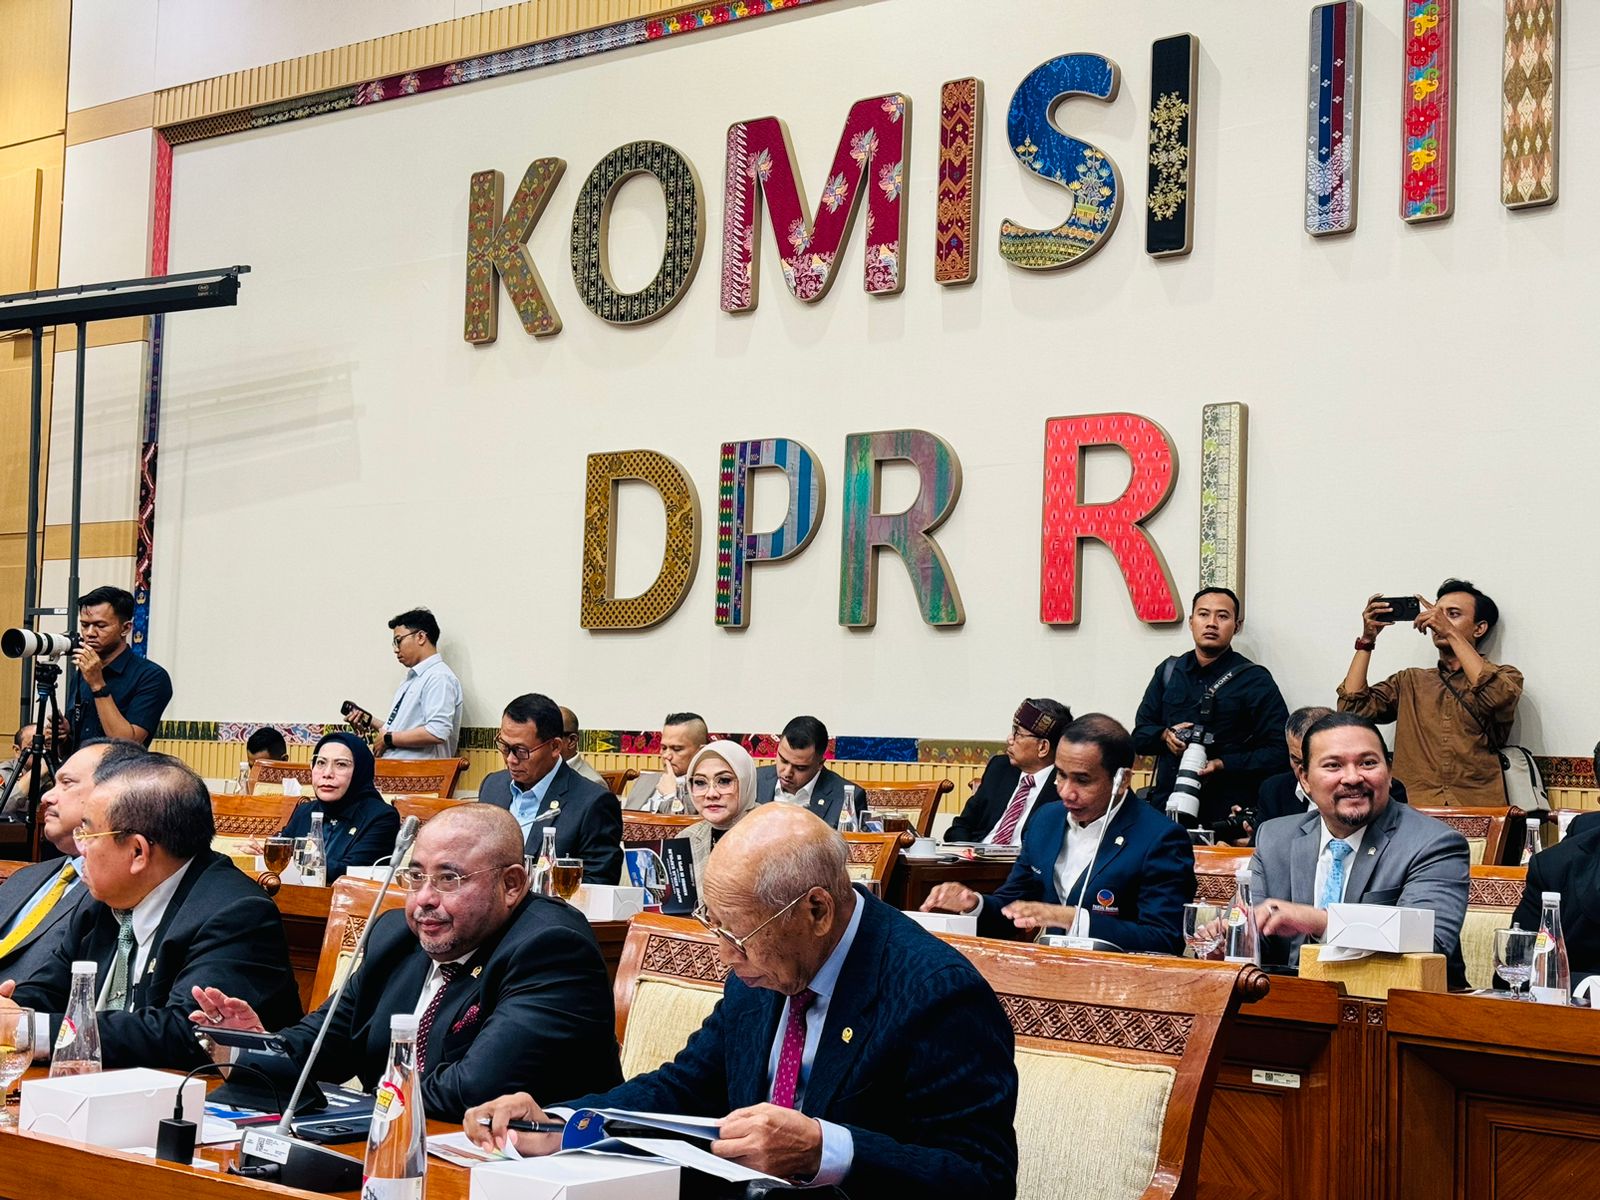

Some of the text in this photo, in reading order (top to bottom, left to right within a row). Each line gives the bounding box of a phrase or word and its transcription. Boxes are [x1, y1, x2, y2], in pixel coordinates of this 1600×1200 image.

[464, 0, 1560, 343] KOMISI III
[580, 401, 1248, 631] DPR RI
[1213, 671, 1233, 688] SONY
